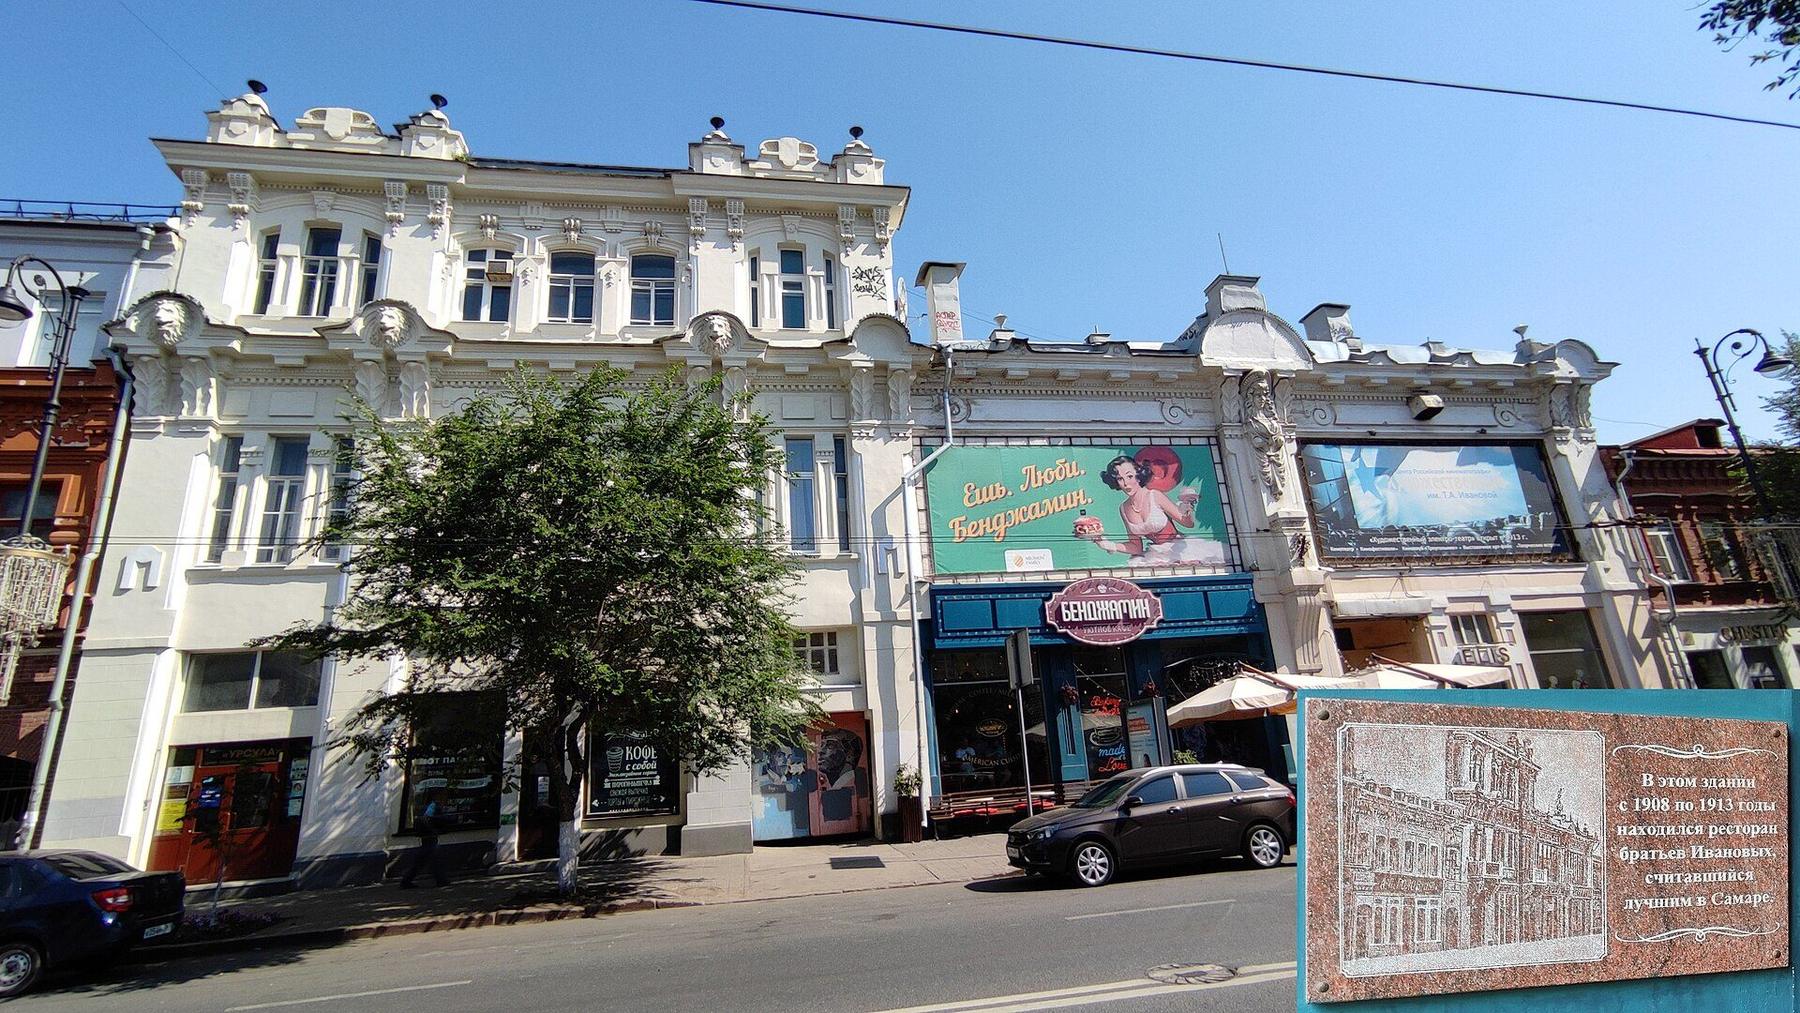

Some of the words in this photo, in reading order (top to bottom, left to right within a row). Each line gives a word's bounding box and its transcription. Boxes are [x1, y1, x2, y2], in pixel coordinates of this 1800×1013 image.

[963, 482, 1014, 508] Ешь.
[1020, 458, 1087, 492] Люби.
[948, 488, 1094, 543] Бенджамин.
[1060, 598, 1151, 622] БЕНДЖАМИН
[625, 745, 658, 761] КОФЕ
[1098, 744, 1126, 758] made
[632, 760, 657, 770] собой
[1641, 773, 1653, 788] В
[1658, 774, 1697, 788] этом
[1701, 774, 1756, 790] здании
[1619, 801, 1628, 811] с
[1634, 798, 1670, 812] 1908
[1674, 801, 1694, 812] по
[1699, 797, 1733, 811] 1913
[1738, 799, 1776, 812] годы
[1617, 823, 1704, 836] находился
[1708, 823, 1778, 838] ресторан
[1619, 846, 1686, 865] братьев
[1690, 845, 1776, 860] Ивановых,
[1644, 869, 1755, 884] считавшийся
[1623, 896, 1692, 912] лучшим
[1697, 896, 1706, 906] в
[1711, 892, 1774, 908] Самаре.
